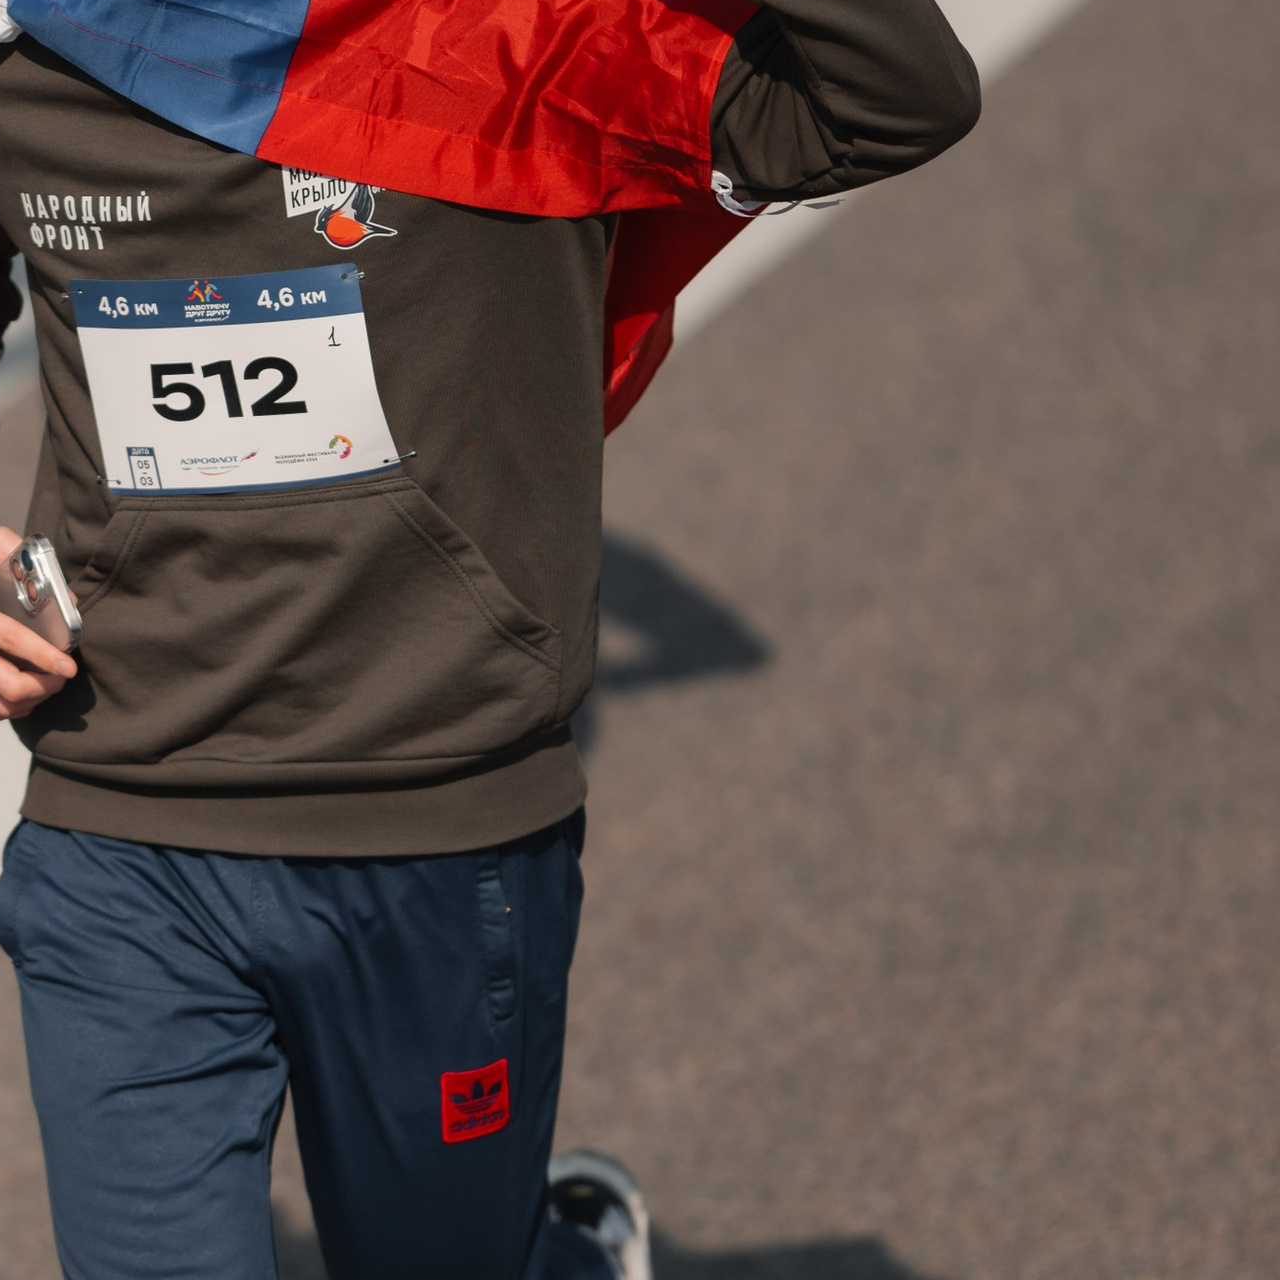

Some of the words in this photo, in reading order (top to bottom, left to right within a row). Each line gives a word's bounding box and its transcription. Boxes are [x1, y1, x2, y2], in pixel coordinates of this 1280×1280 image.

[291, 178, 347, 209] КРЫЛО
[20, 190, 152, 224] НАРОДНЫЙ
[30, 222, 104, 250] ФРОНТ
[98, 295, 130, 319] 4,6
[257, 287, 294, 311] 4,6
[328, 326, 341, 347] 1
[150, 356, 308, 422] 512
[137, 460, 150, 469] 05
[180, 456, 238, 465] АЭРОФЛОТ
[140, 476, 154, 486] 03
